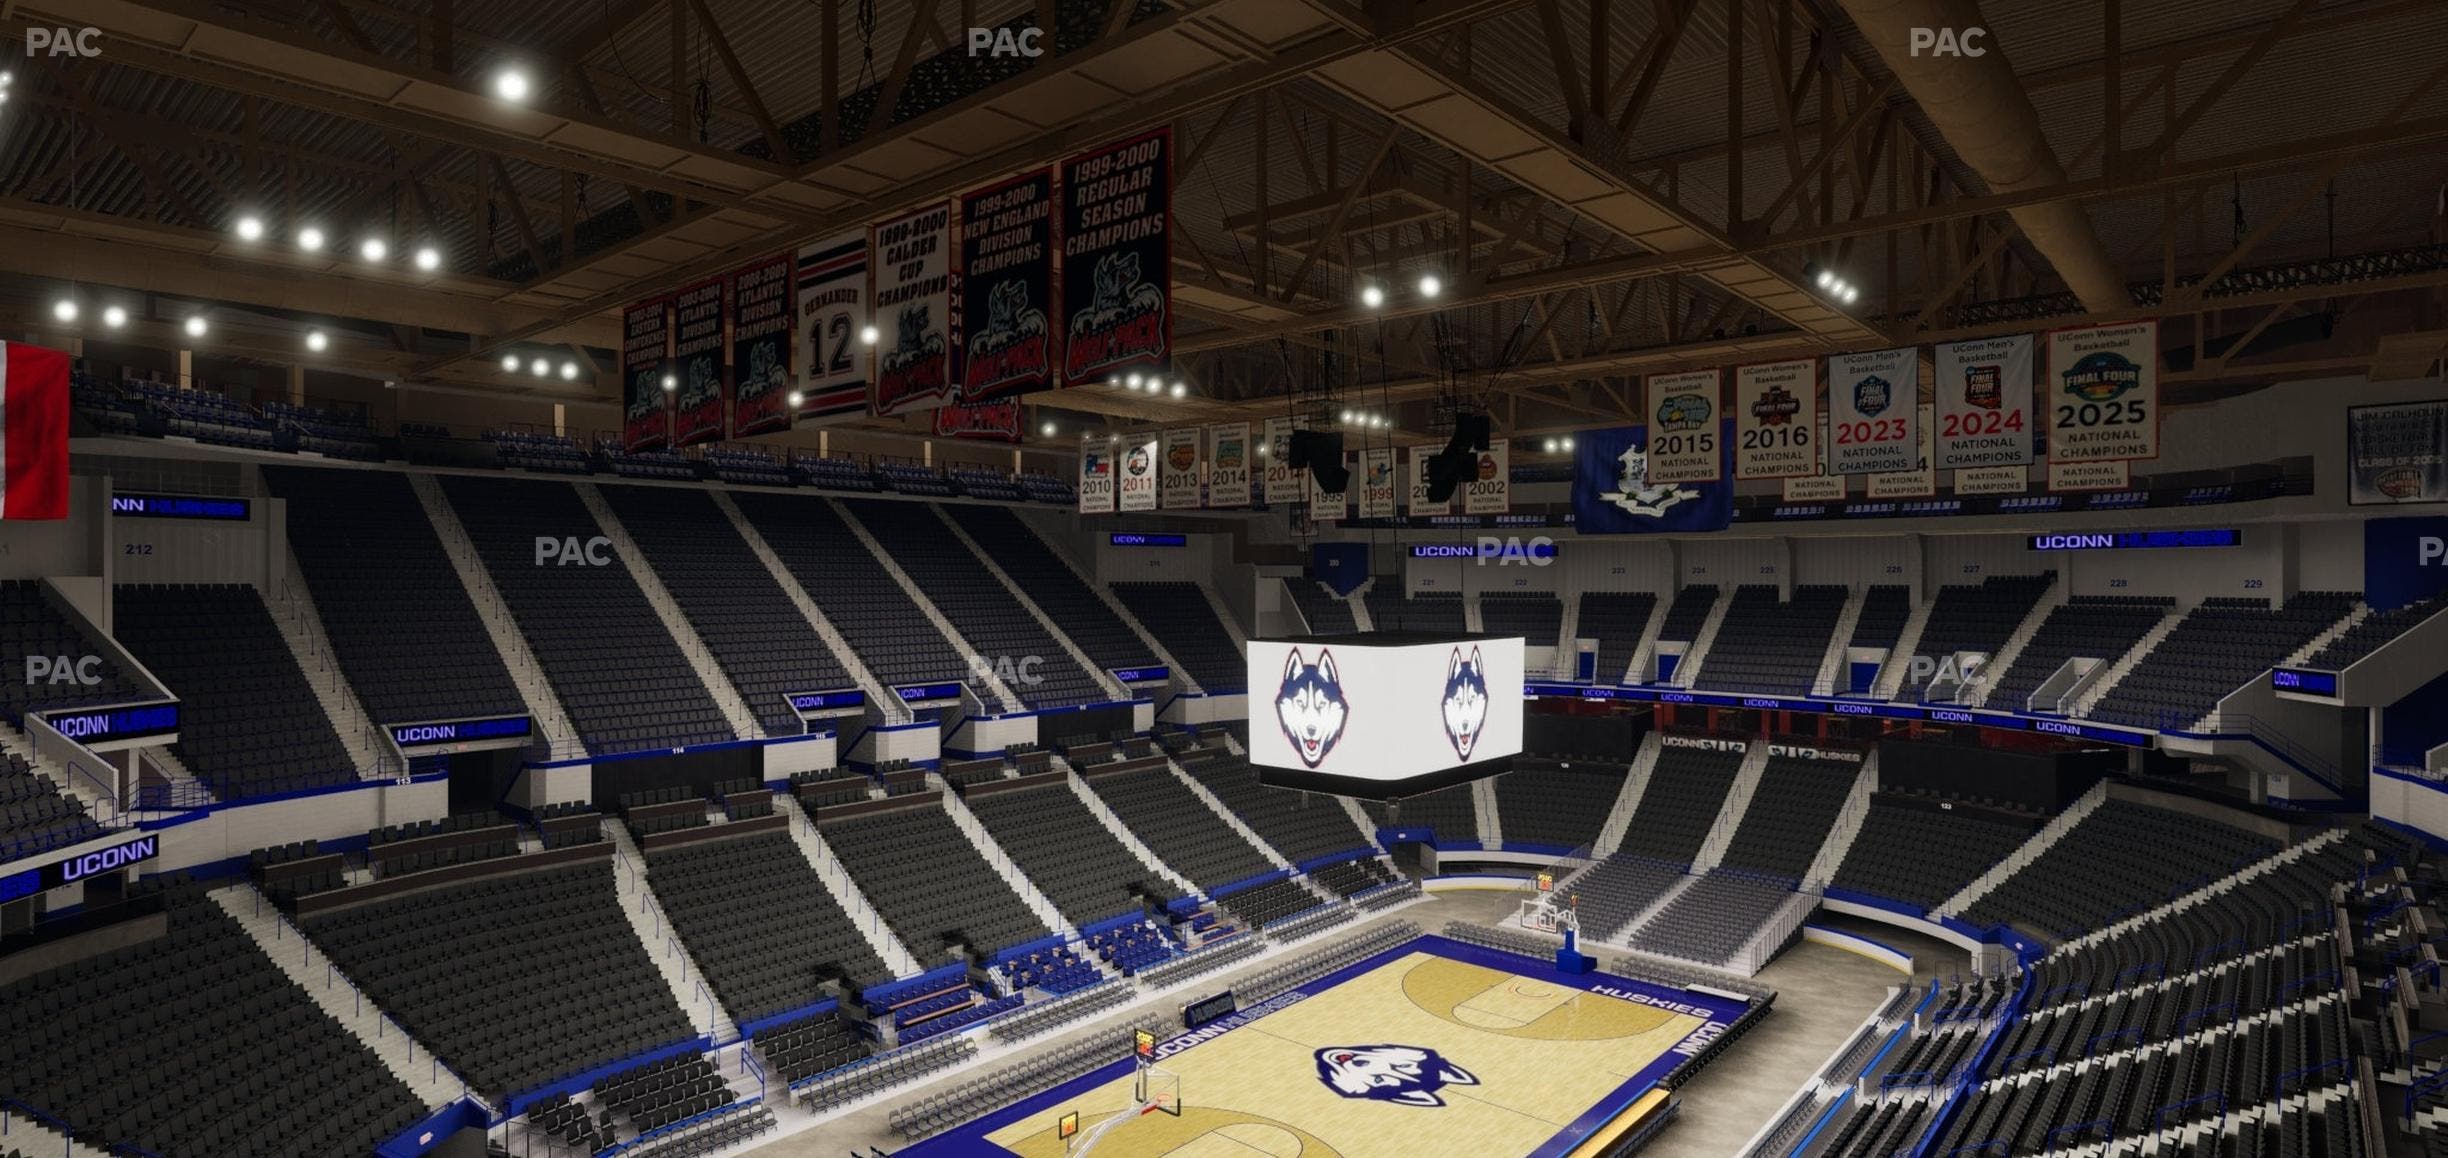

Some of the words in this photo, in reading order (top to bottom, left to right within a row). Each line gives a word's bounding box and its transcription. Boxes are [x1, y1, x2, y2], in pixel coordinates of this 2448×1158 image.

[1074, 138, 1160, 184] 1999-2000
[1075, 166, 1154, 207] REGULAR
[974, 183, 1037, 218] 1999-2000
[1080, 192, 1148, 230] SEASON
[964, 215, 998, 240] NEW
[999, 200, 1049, 230] ENGLAND
[978, 224, 1033, 254] DIVISION
[1065, 212, 1164, 257] CHAMPIONS
[886, 235, 938, 266] CALDER
[970, 242, 1042, 277] CHAMPIONS
[899, 260, 924, 283] CUP
[738, 280, 785, 311] ATLANTIC
[877, 274, 947, 309] CHAMPIONS
[741, 298, 782, 325] DIVISION
[735, 314, 789, 341] CHAMPIONS
[2057, 332, 2094, 342] UConn
[2097, 326, 2147, 339] Women's
[676, 333, 723, 358] CHAMPIONS
[809, 312, 854, 380] 12
[1953, 343, 1985, 354] UConn
[1987, 338, 2015, 350] Men's
[2073, 339, 2130, 351] Basketball
[1843, 354, 1873, 364] UConn
[1875, 351, 1902, 361] Men's
[1958, 351, 2009, 364] Basketball
[1743, 367, 1770, 376] UConn
[1771, 363, 1809, 374] Women's
[1849, 363, 1896, 375] Basketball
[1755, 374, 1797, 385] Basketball
[1970, 373, 1994, 384] FINAL
[2066, 372, 2100, 387] FINAL
[2102, 370, 2137, 383] FOUR
[2057, 400, 2146, 429] 2025
[1942, 409, 2025, 437] 2024
[1743, 425, 1809, 450] 2016
[1837, 418, 1907, 444] 2023
[2068, 430, 2141, 444] NATIONAL
[1654, 433, 1714, 455] 2015
[1951, 437, 2016, 450] NATIONAL
[1750, 451, 1805, 463] NATIONAL
[1843, 446, 1903, 458] NATIONAL
[1946, 451, 2022, 465] CHAMPIONS
[2060, 444, 2147, 458] CHAMPIONS
[1661, 457, 1710, 468] NATIONAL
[1744, 463, 1810, 476] CHAMPIONS
[1838, 459, 1908, 472] CHAMPIONS
[1212, 470, 1246, 485] 2014
[1655, 469, 1715, 480] CHAMPIONS
[1967, 472, 2016, 481] NATIONAL
[2062, 467, 2116, 477] NATIONAL
[1082, 479, 1112, 494] 2010
[1123, 477, 1151, 492] 2011
[1165, 473, 1198, 489] 2013
[1794, 481, 1836, 489] NATIONAL
[1879, 475, 1925, 485] NATIONAL
[1962, 482, 2021, 492] CHAMPIONS
[2057, 478, 2122, 488] CHAMPIONS
[1363, 487, 1394, 500] 1999
[1468, 481, 1506, 496] 2002
[1790, 490, 1840, 499] CHAMPIONS
[1874, 486, 1929, 496] CHAMPIONS
[1113, 535, 1146, 544] UCONN
[2036, 534, 2114, 550] UCONN
[126, 544, 152, 555] 212
[1415, 545, 1474, 558] UCONN
[2244, 580, 2262, 589] 229
[2273, 671, 2300, 688] UCONN
[1582, 690, 1615, 698] UCONN
[1660, 694, 1694, 703] UCONN
[1743, 699, 1779, 708] UCONN
[1834, 704, 1873, 715] UCONN
[1931, 711, 1973, 722] UCONN
[53, 714, 109, 738] UCONN
[2036, 720, 2082, 736] UCONN
[397, 724, 456, 743] UCONN
[1662, 736, 1701, 749] UCONN
[1819, 750, 1861, 762] HUSKIES
[63, 838, 154, 882] UCONN
[1590, 985, 1715, 1018] HUSKIES
